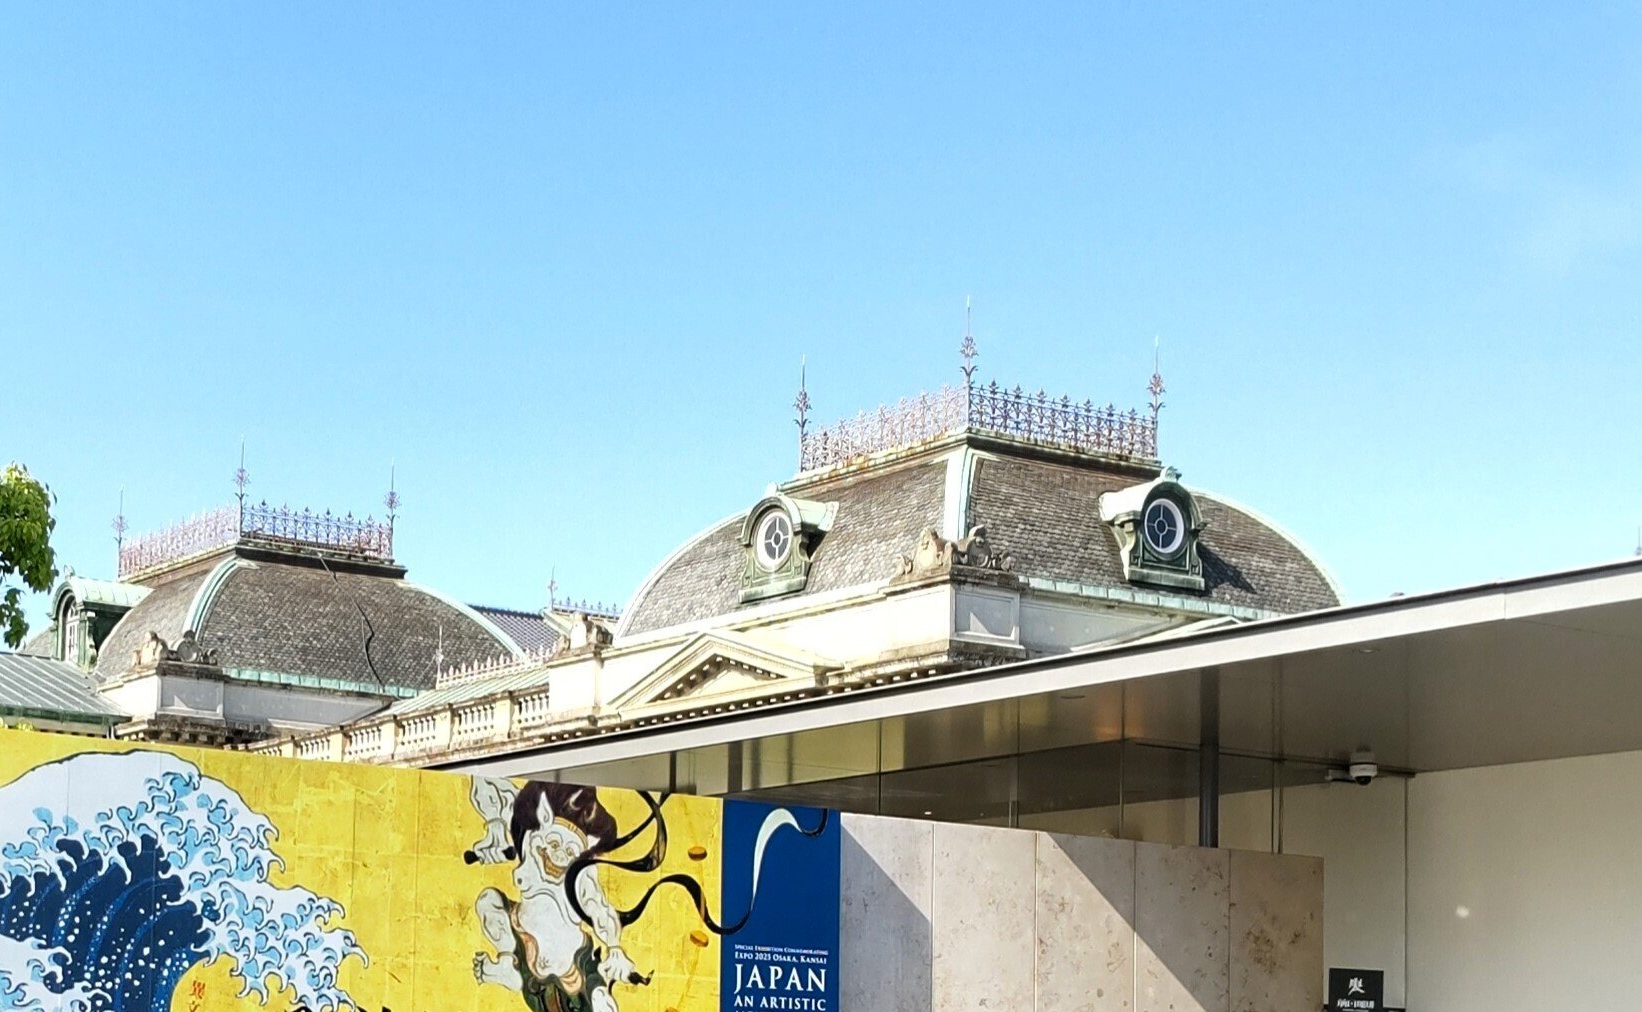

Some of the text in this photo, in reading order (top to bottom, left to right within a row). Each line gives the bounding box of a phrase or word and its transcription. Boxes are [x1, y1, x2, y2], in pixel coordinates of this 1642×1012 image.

[733, 963, 826, 995] JAPAN
[733, 994, 826, 1011] AN ARTISTIC
